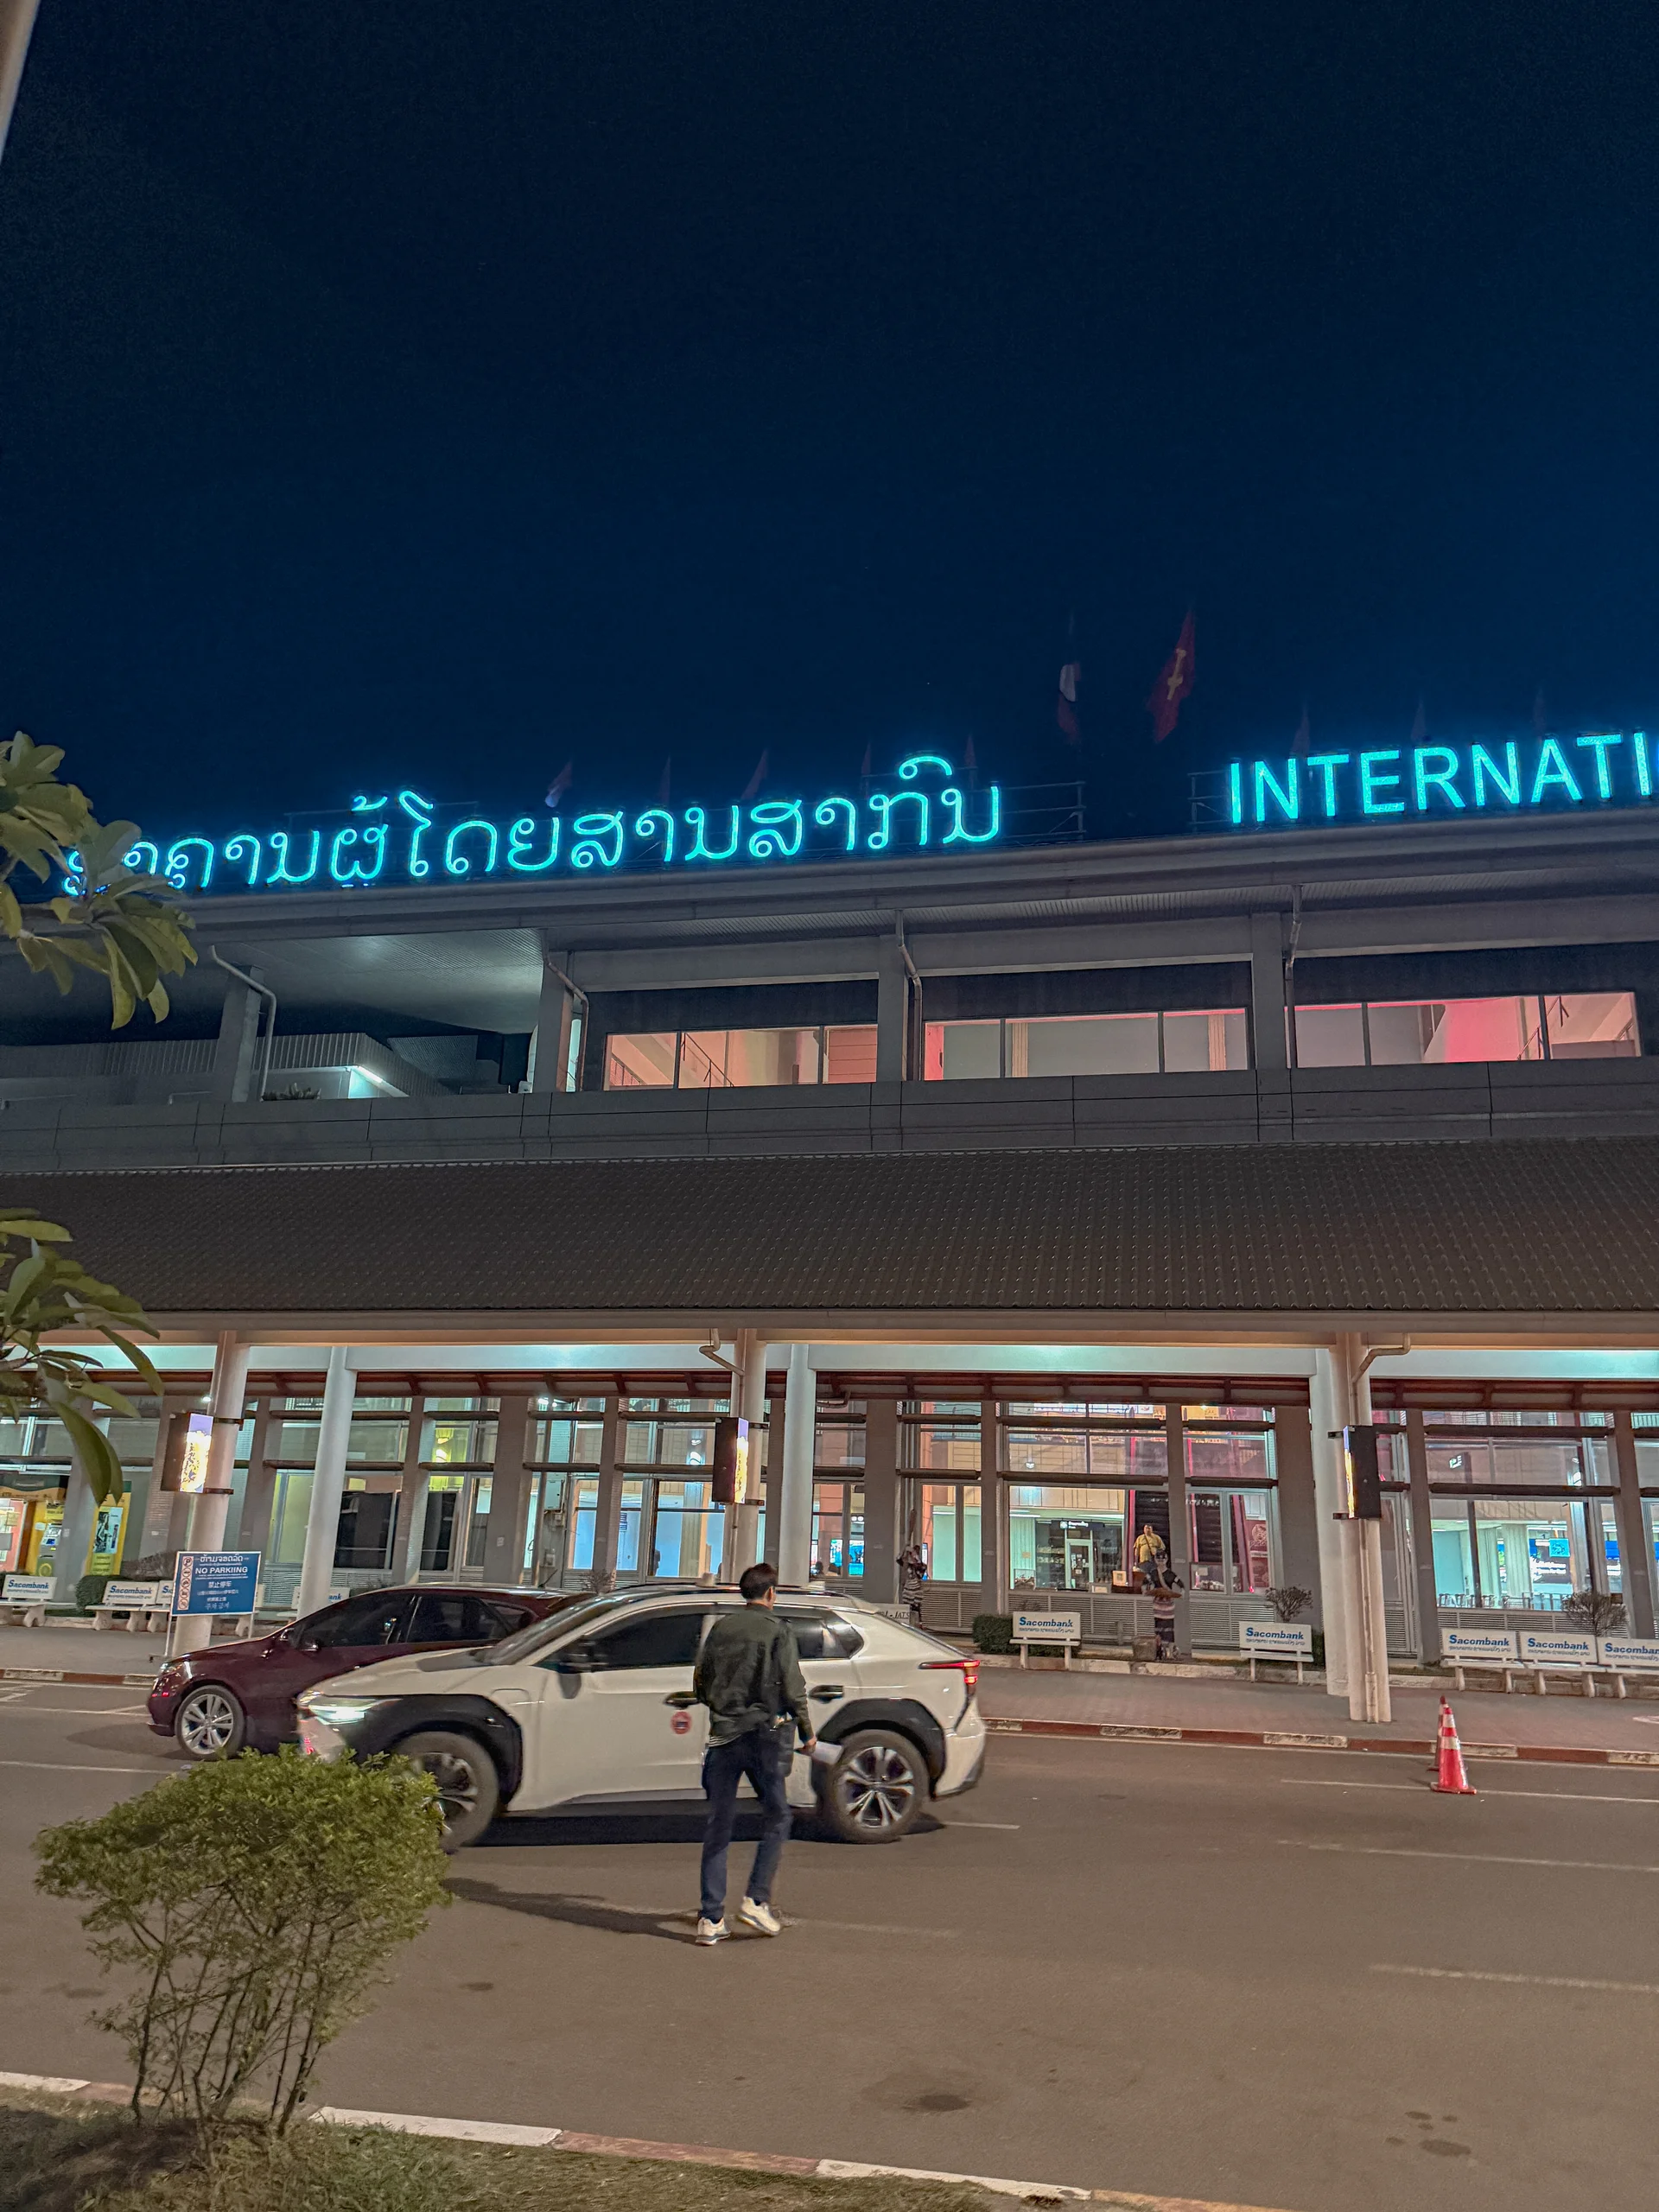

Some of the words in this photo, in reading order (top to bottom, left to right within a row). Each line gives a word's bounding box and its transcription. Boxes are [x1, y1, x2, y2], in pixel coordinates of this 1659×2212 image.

[1229, 731, 1654, 824] INTERNATI
[62, 754, 1001, 896] າຄານຜ້ໂດຍສານສາກົນ
[8, 1580, 49, 1590] Sacombank
[110, 1586, 153, 1595] Sacombank
[1019, 1617, 1073, 1628] Sacombank
[1246, 1627, 1304, 1640] Sacombank
[1449, 1634, 1510, 1647] Sacombank
[1528, 1637, 1589, 1650] Sacombank
